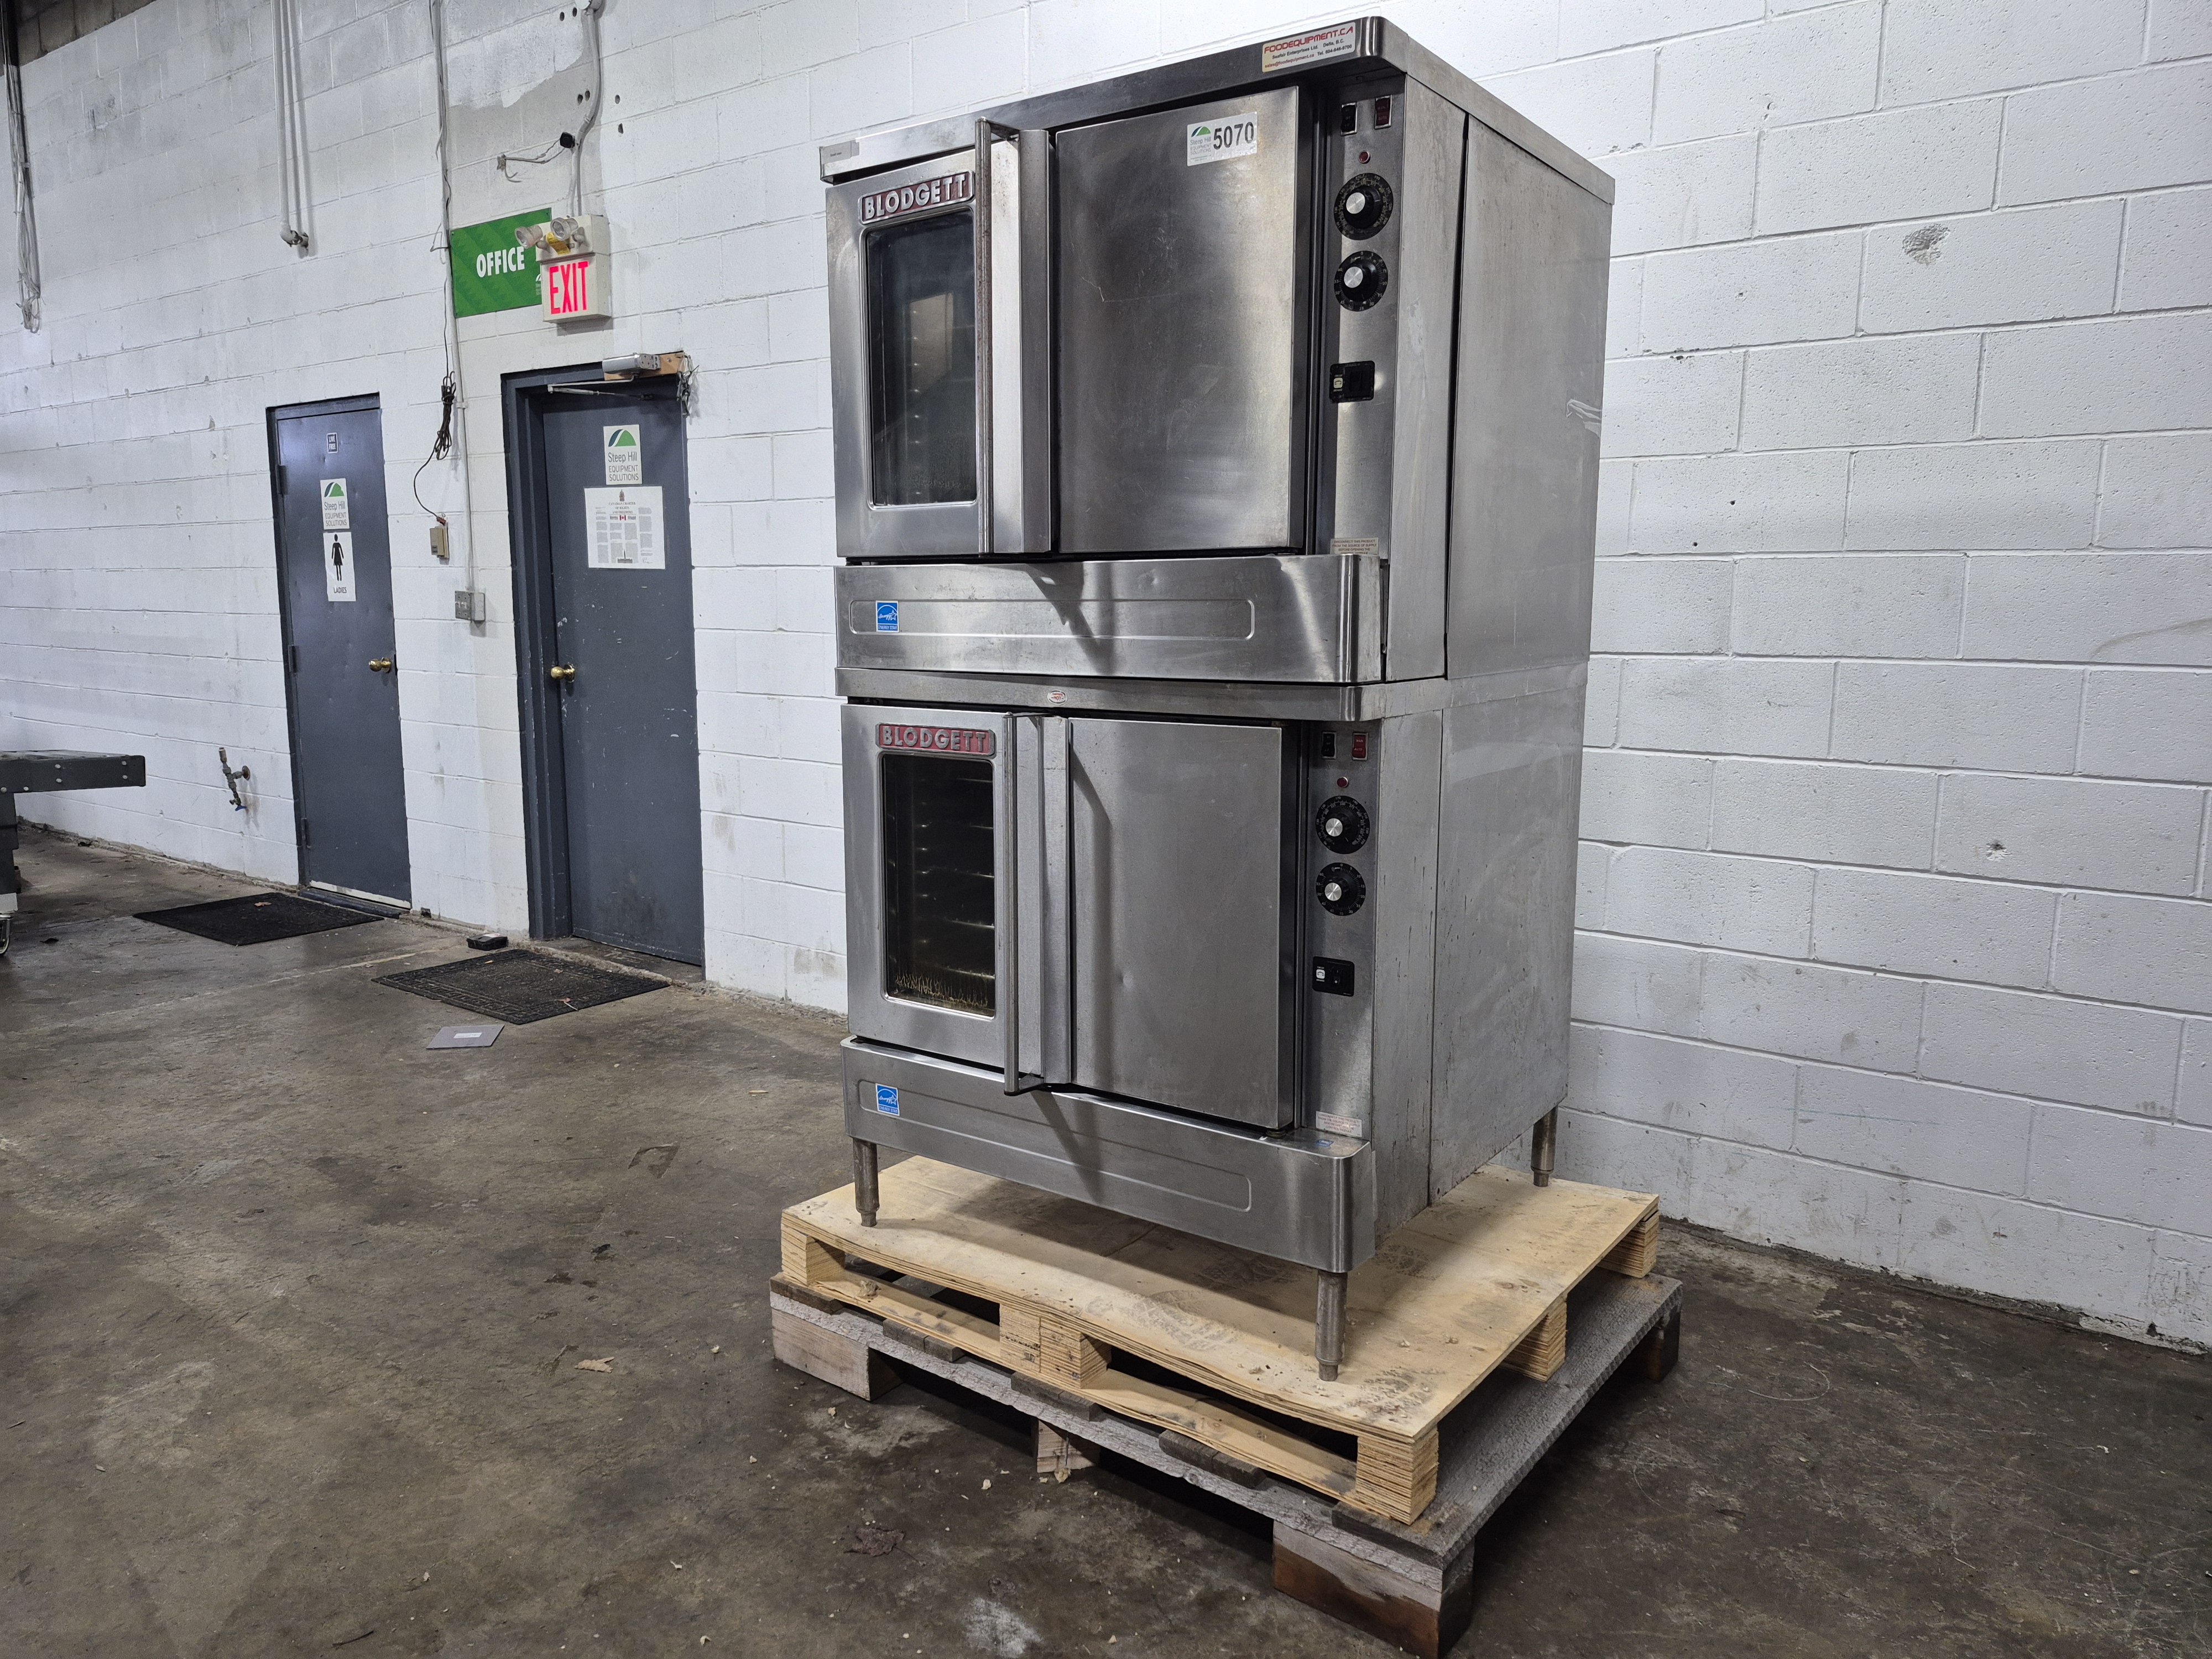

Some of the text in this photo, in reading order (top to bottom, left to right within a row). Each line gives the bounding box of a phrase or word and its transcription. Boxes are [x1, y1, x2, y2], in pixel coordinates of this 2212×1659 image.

[1264, 26, 1353, 54] FOODEQUIPMENT.CA
[1287, 47, 1310, 56] Enterprises
[1265, 54, 1314, 68] sales@foodequipment.ca
[1213, 122, 1254, 149] 5070
[865, 174, 966, 220] BLODGETT
[477, 247, 525, 278] OFFICE
[549, 260, 589, 315] EXIT
[608, 451, 637, 463] Steep Hill
[324, 502, 337, 511] Steep
[883, 726, 985, 752] BLODGETT
